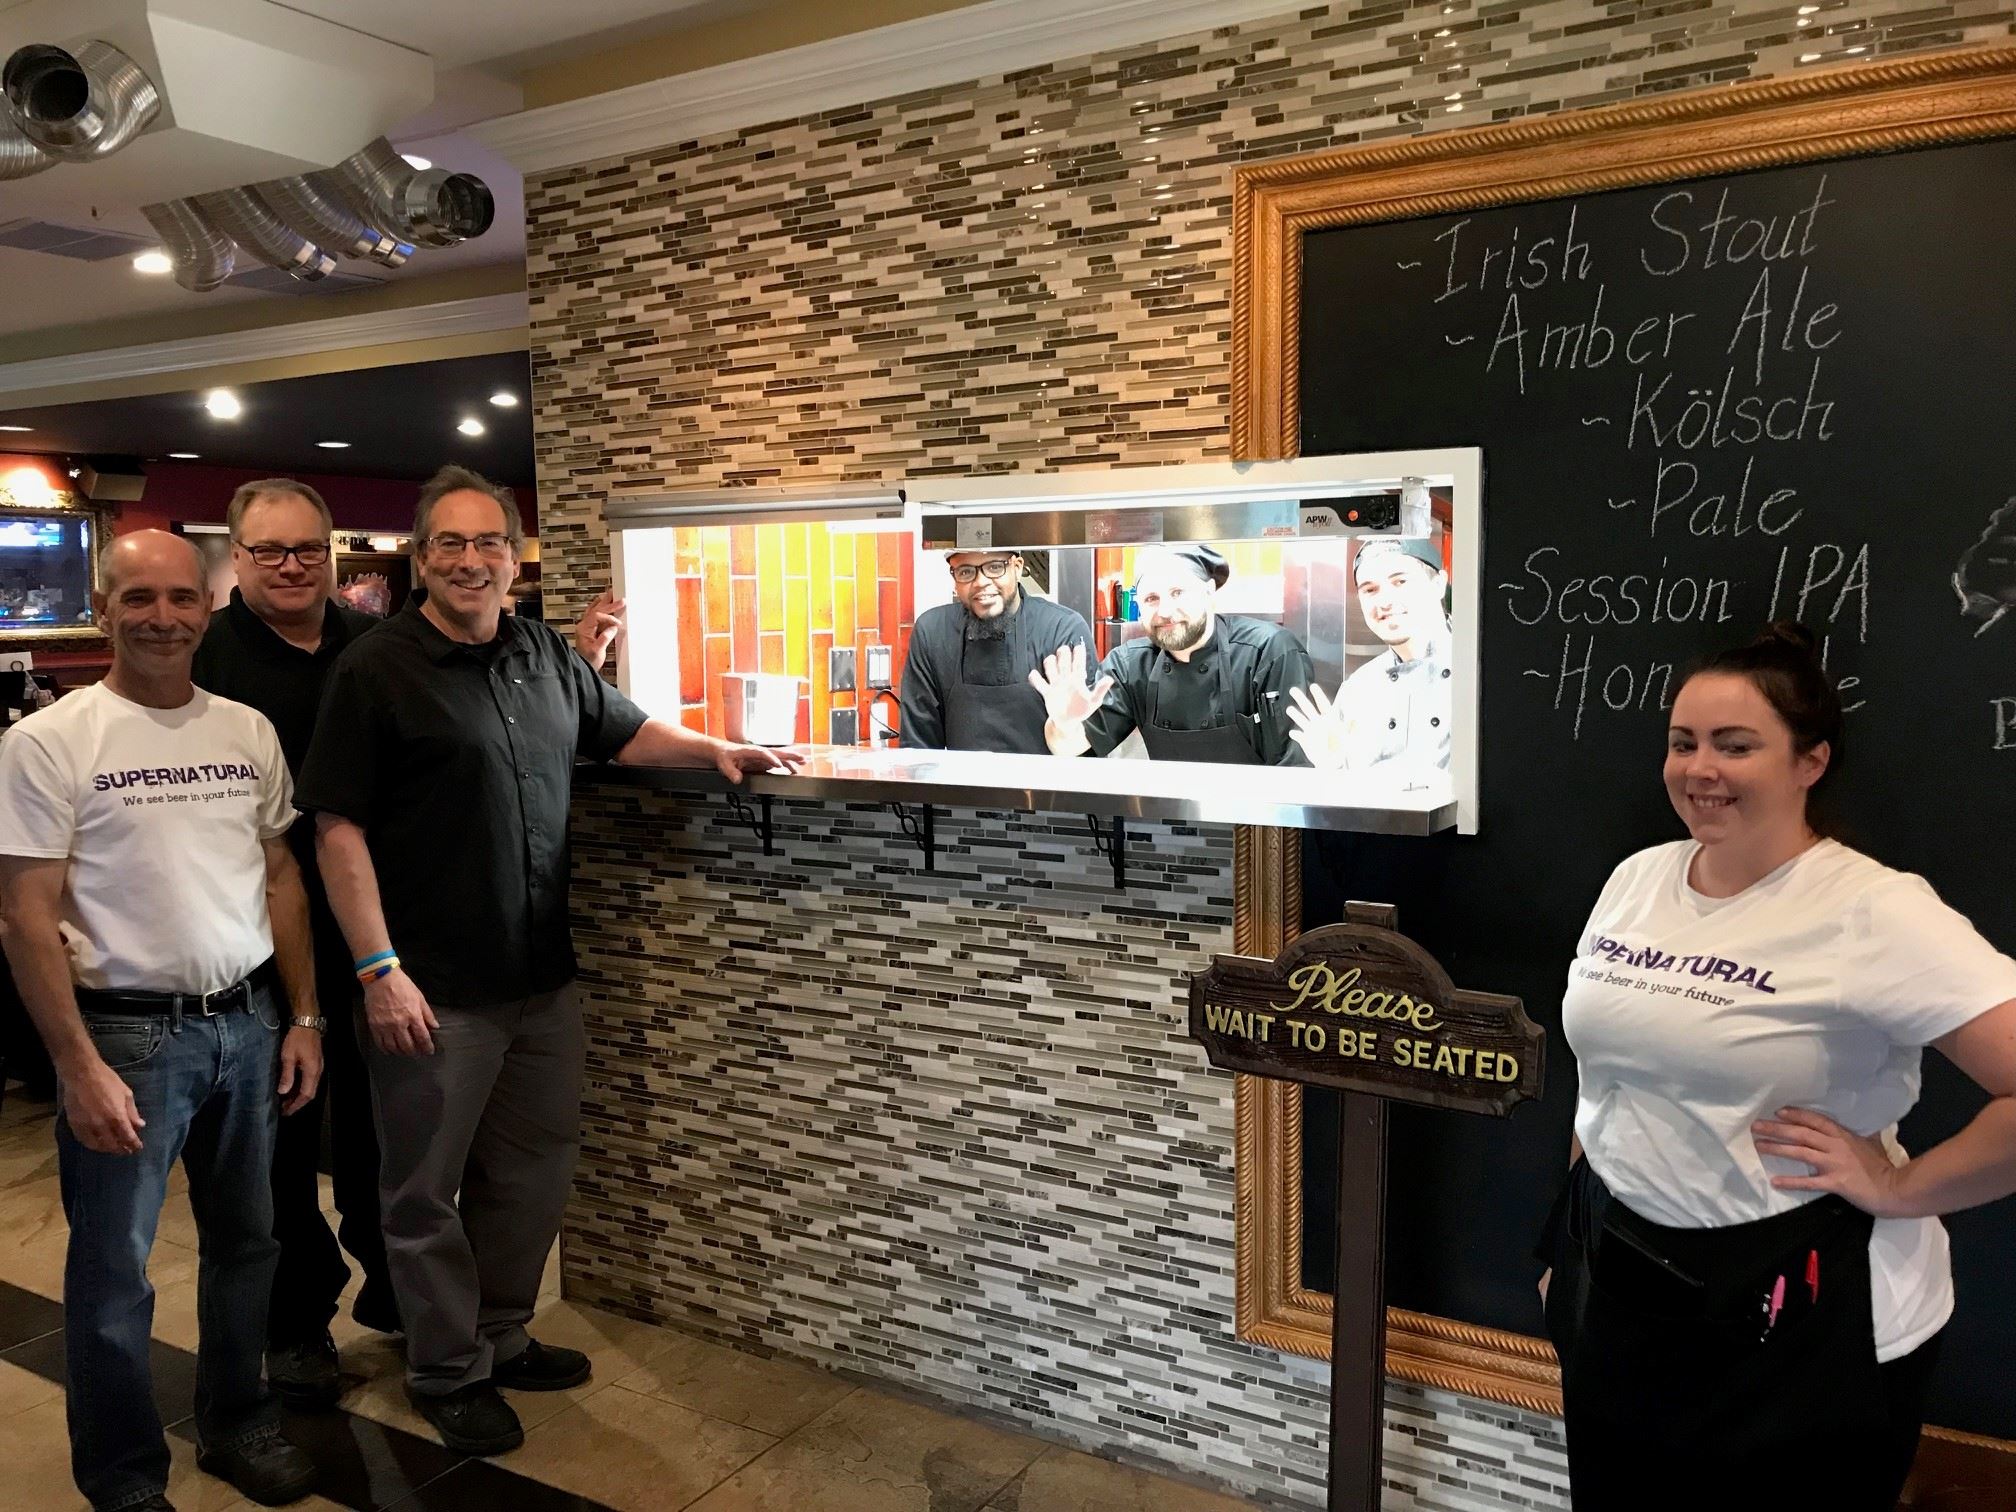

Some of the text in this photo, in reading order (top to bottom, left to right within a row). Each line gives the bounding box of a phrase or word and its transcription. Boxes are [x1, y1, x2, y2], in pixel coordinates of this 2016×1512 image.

[1641, 174, 1836, 276] Stout
[1486, 266, 1842, 395] Amber Ale
[1651, 456, 1804, 538] Pale
[1508, 543, 1869, 643] Session IPA
[1554, 633, 1673, 741] Hon
[94, 764, 259, 791] SUPERNATURAL
[123, 795, 143, 806] We
[147, 795, 163, 804] see
[167, 792, 188, 803] beer
[190, 791, 200, 802] in
[200, 790, 225, 801] your
[1269, 960, 1444, 1031] Please
[1587, 971, 1603, 981] see
[1604, 971, 1633, 988] beer
[1633, 977, 1648, 990] in
[1649, 983, 1682, 995] your
[1684, 986, 1735, 1006] future
[1205, 1004, 1519, 1083] WAIT TO BE SEATED
